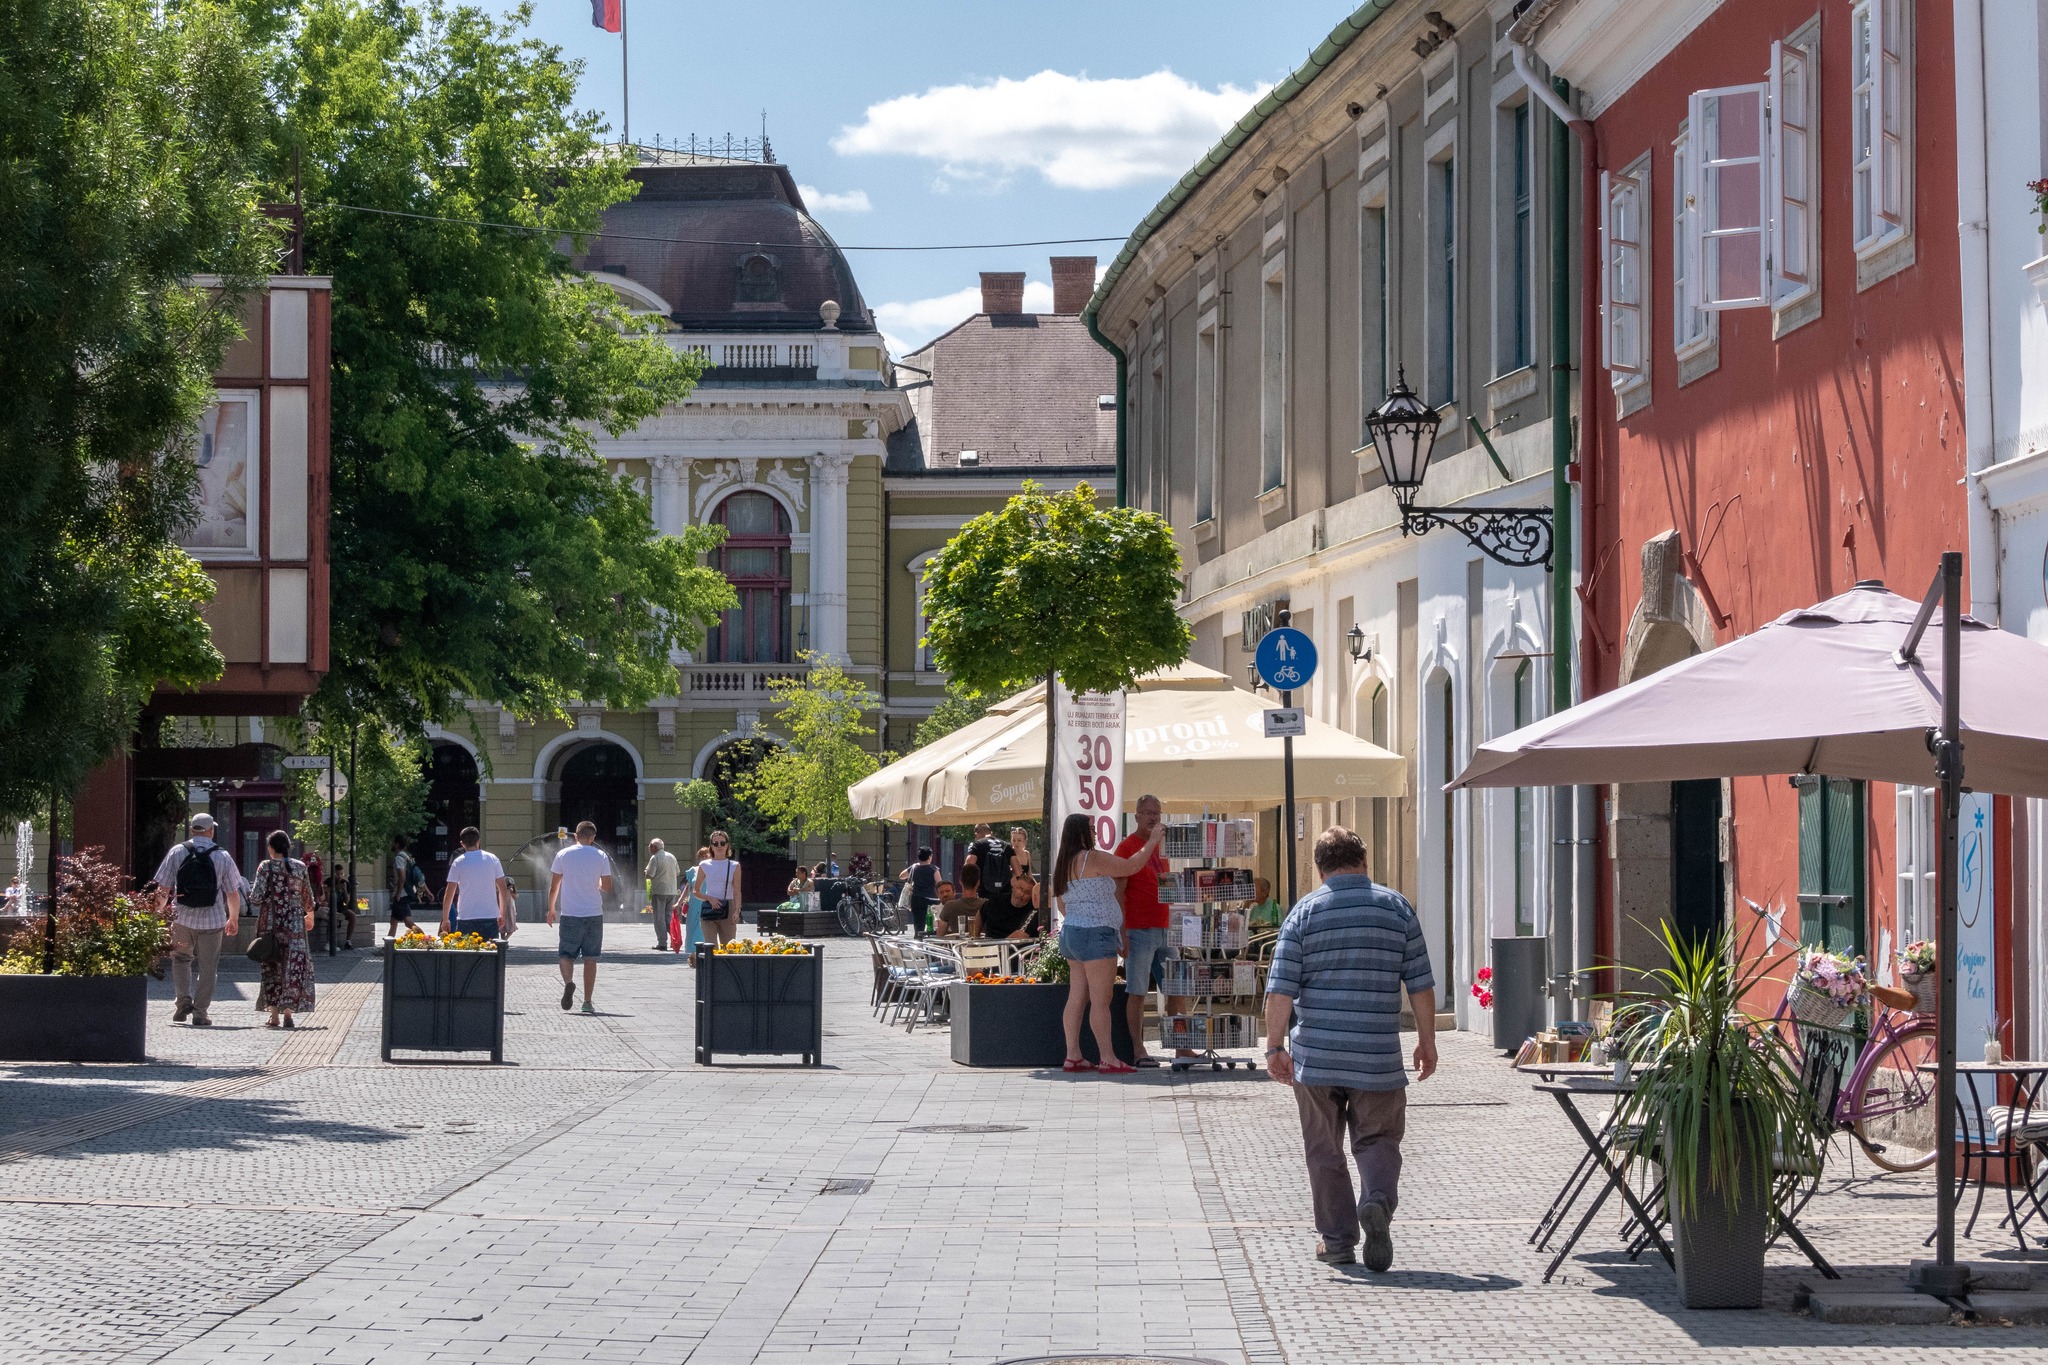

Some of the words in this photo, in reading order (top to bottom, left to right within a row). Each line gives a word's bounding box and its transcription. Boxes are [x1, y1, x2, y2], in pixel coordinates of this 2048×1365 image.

[1067, 710, 1074, 718] ÚJ
[1075, 710, 1095, 719] RUHÁZATI
[1095, 711, 1120, 720] TERMÉKEK
[1075, 720, 1091, 728] EREDETI
[1091, 721, 1104, 729] BOLTI
[1104, 720, 1121, 729] ÁRAK
[1125, 715, 1230, 753] proni
[1076, 734, 1112, 771] 30
[990, 778, 1034, 805] Soproni
[1078, 775, 1115, 811] 50
[1089, 815, 1116, 851] 0
